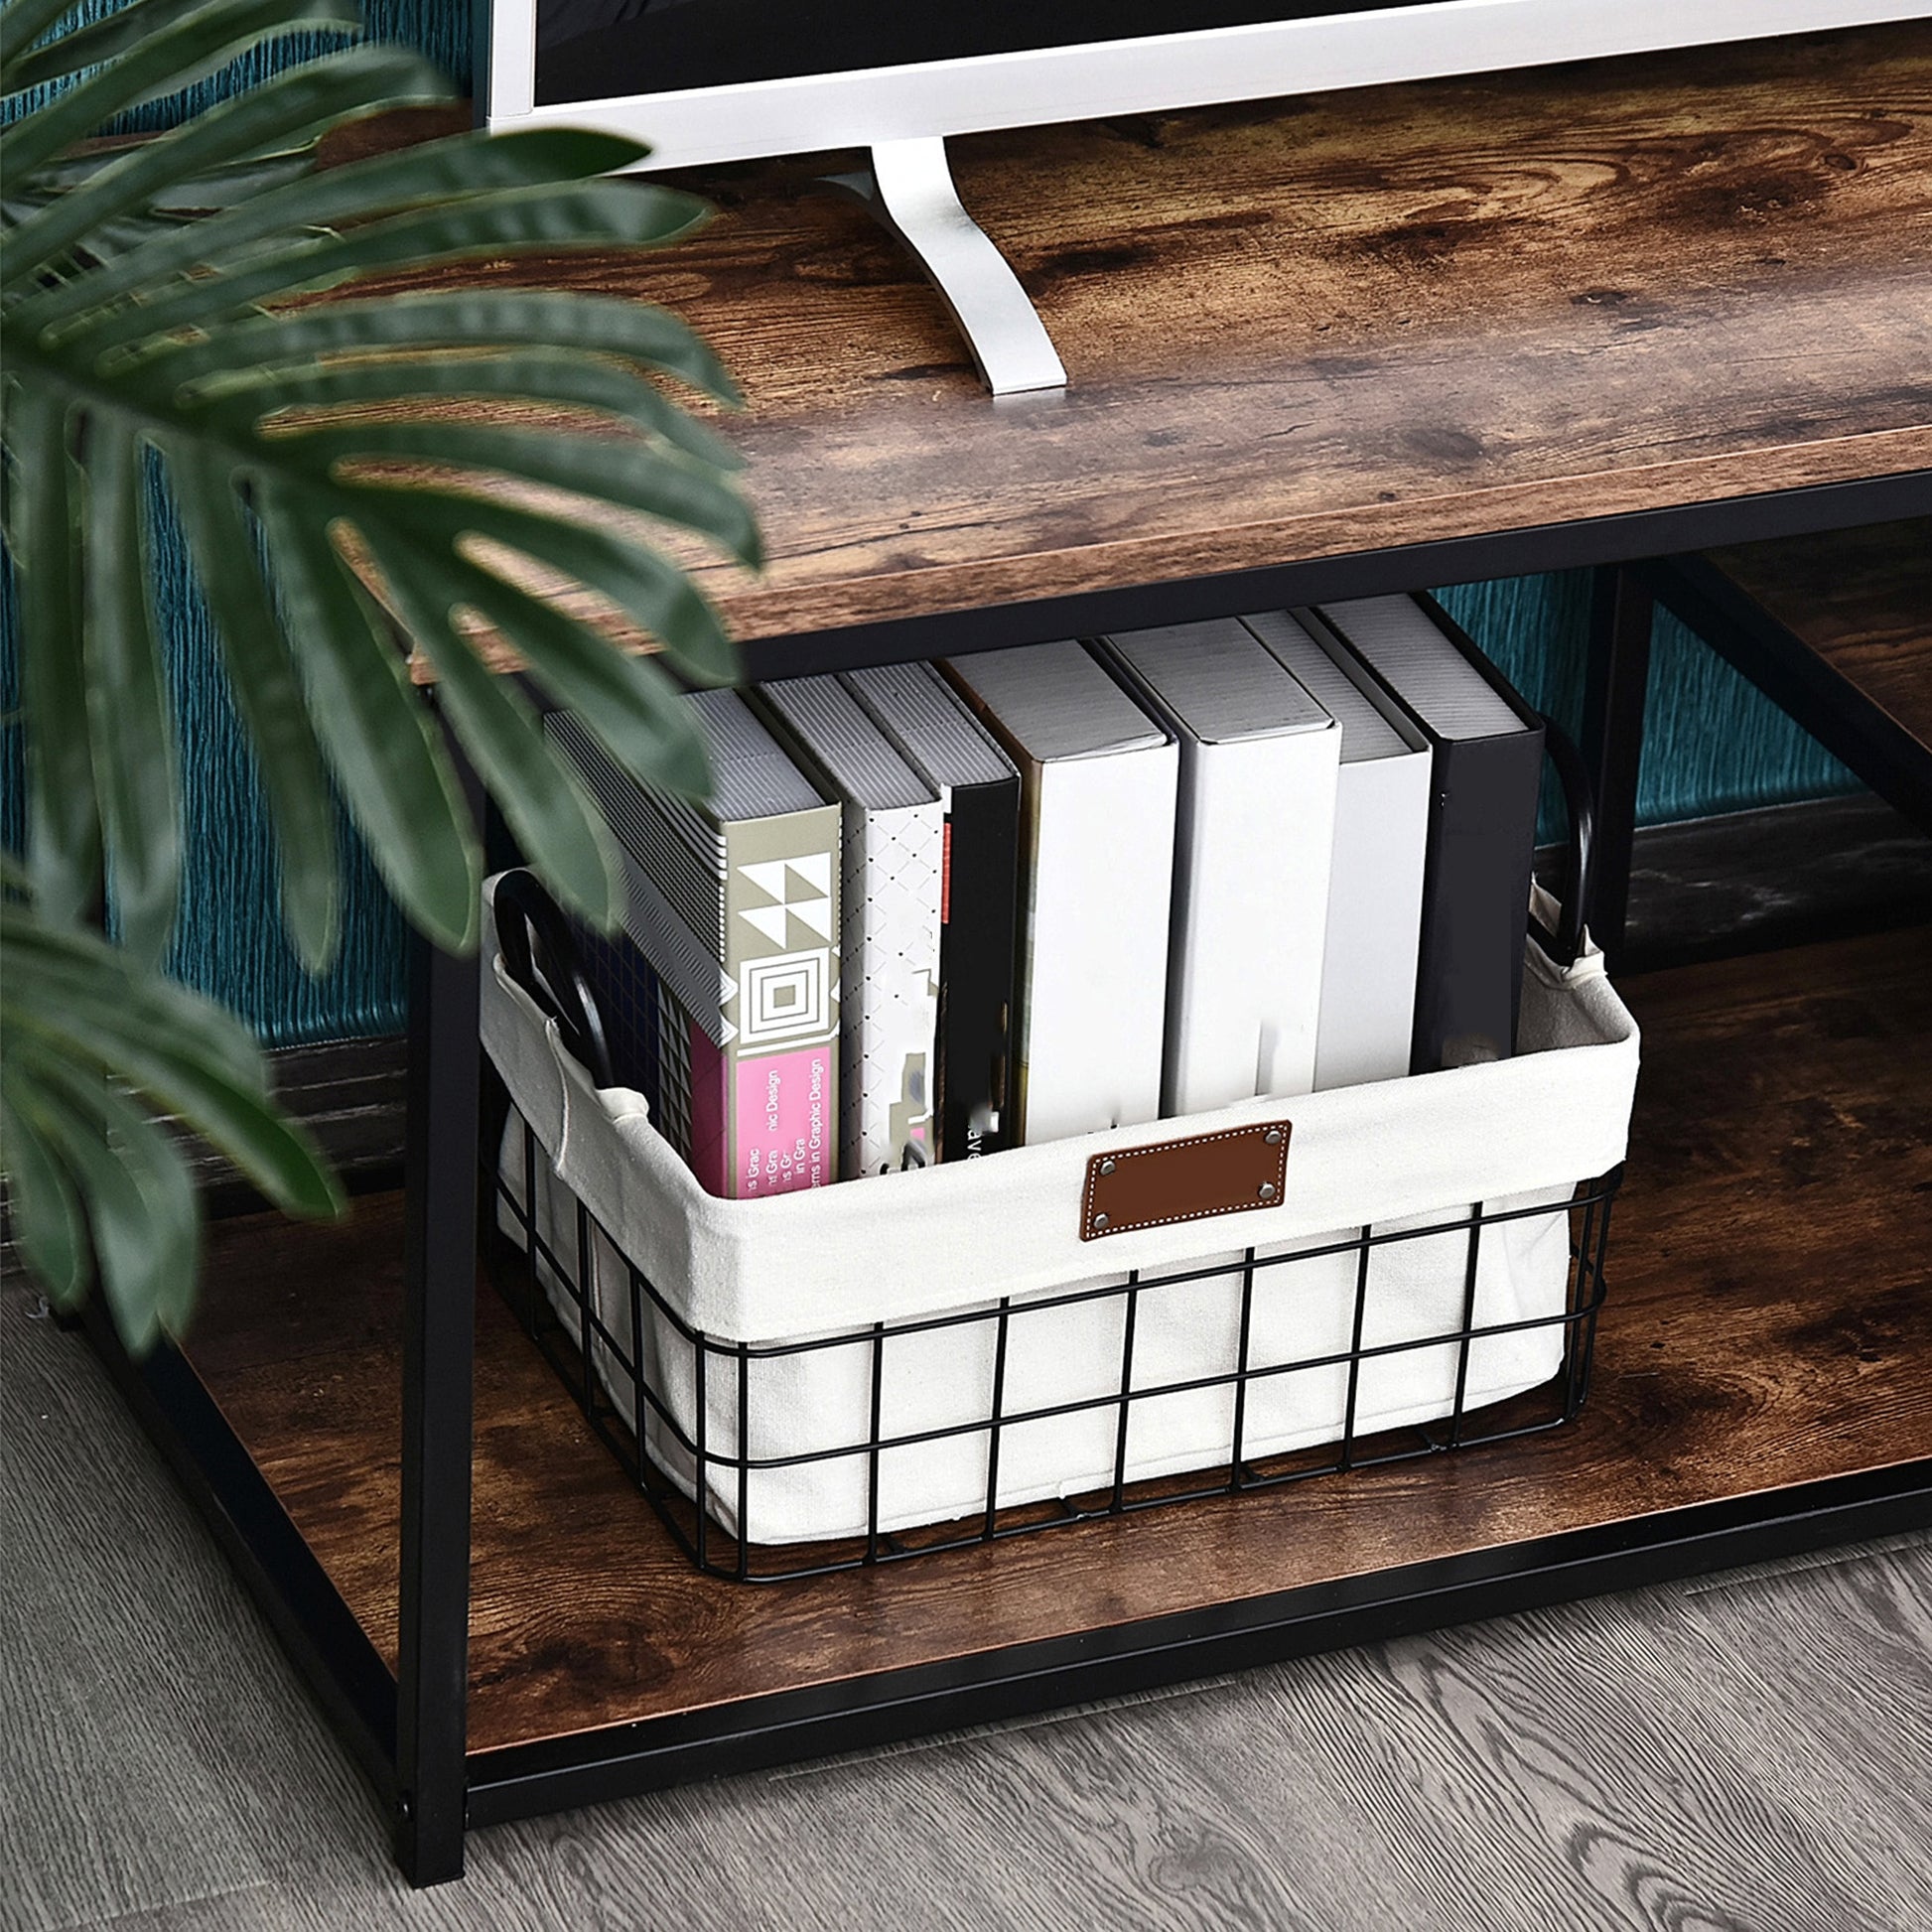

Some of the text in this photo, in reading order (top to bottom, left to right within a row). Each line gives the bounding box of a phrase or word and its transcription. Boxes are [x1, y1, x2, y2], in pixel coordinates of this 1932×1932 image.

[766, 1069, 781, 1112] Design
[809, 1058, 824, 1101] Design
[808, 1103, 823, 1150] Graphic
[809, 1152, 821, 1163] in
